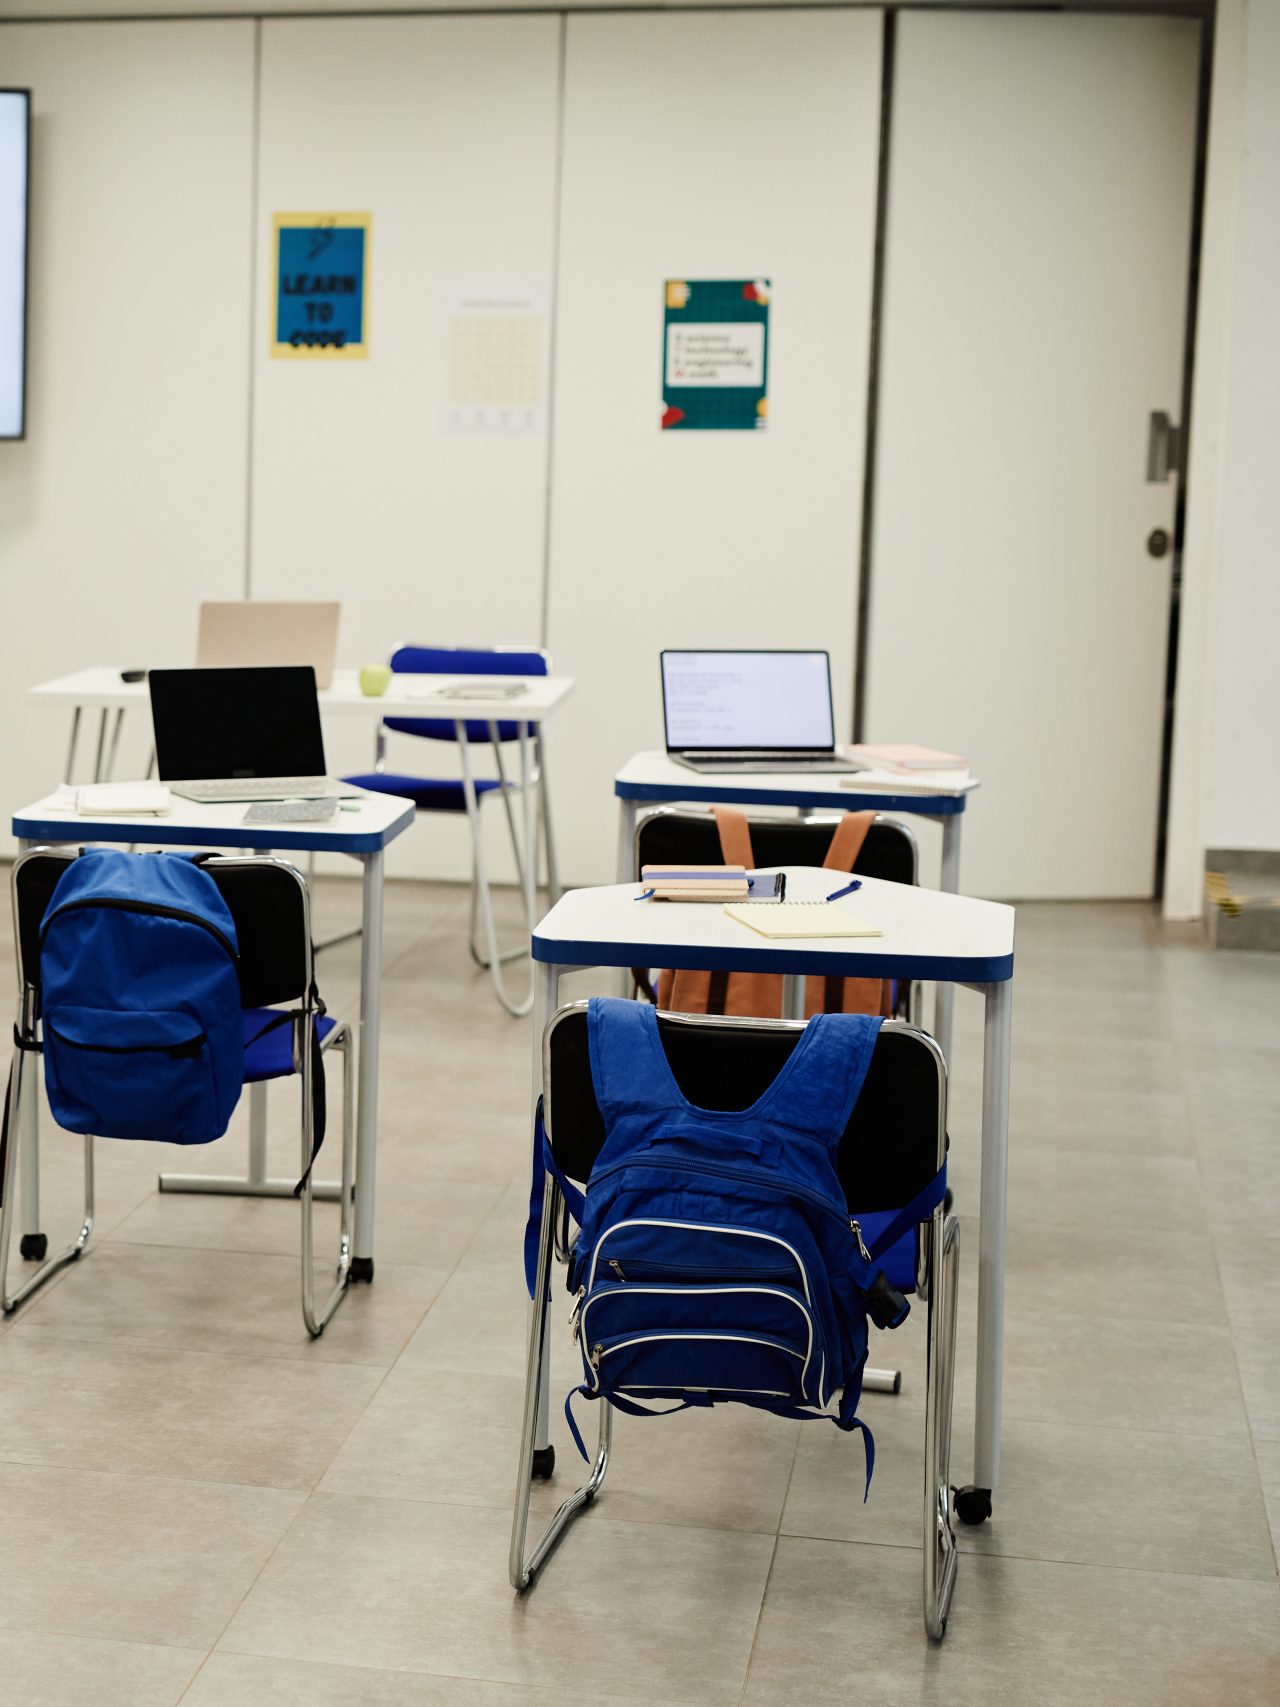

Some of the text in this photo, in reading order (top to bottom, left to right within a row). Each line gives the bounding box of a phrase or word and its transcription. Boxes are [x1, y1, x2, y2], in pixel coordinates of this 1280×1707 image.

[282, 274, 356, 296] LEARN
[304, 302, 334, 323] TO
[289, 330, 347, 349] CODE
